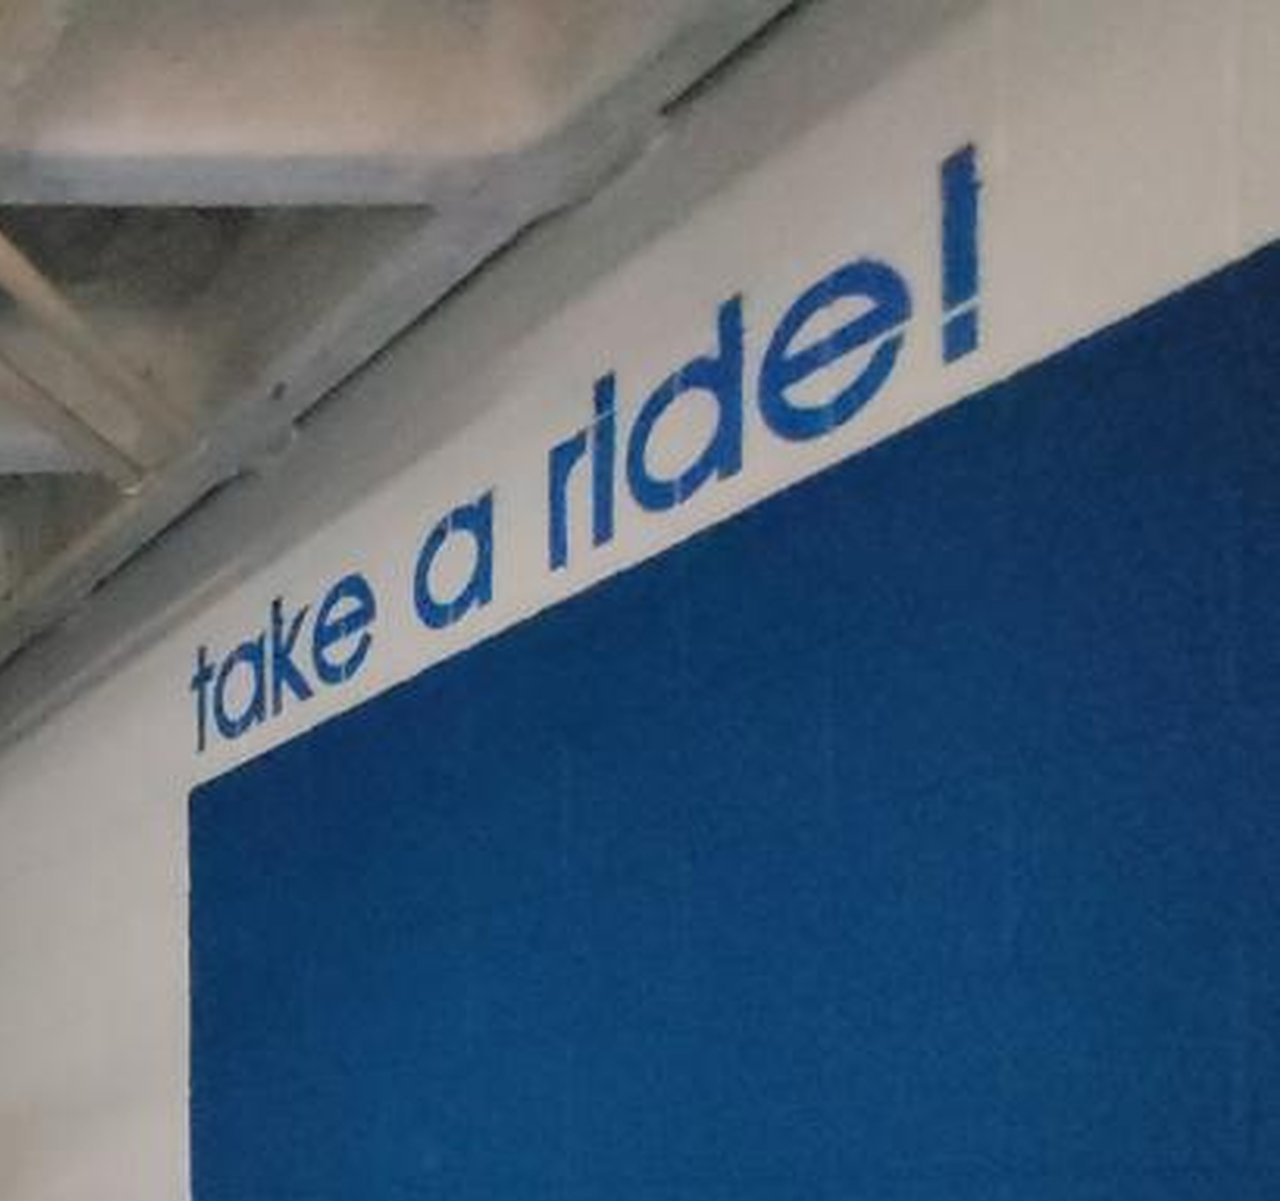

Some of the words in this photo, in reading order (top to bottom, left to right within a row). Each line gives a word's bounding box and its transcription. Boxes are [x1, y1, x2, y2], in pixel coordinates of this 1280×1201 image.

[191, 572, 377, 752] take
[413, 487, 496, 630] a
[548, 142, 982, 571] ride!
